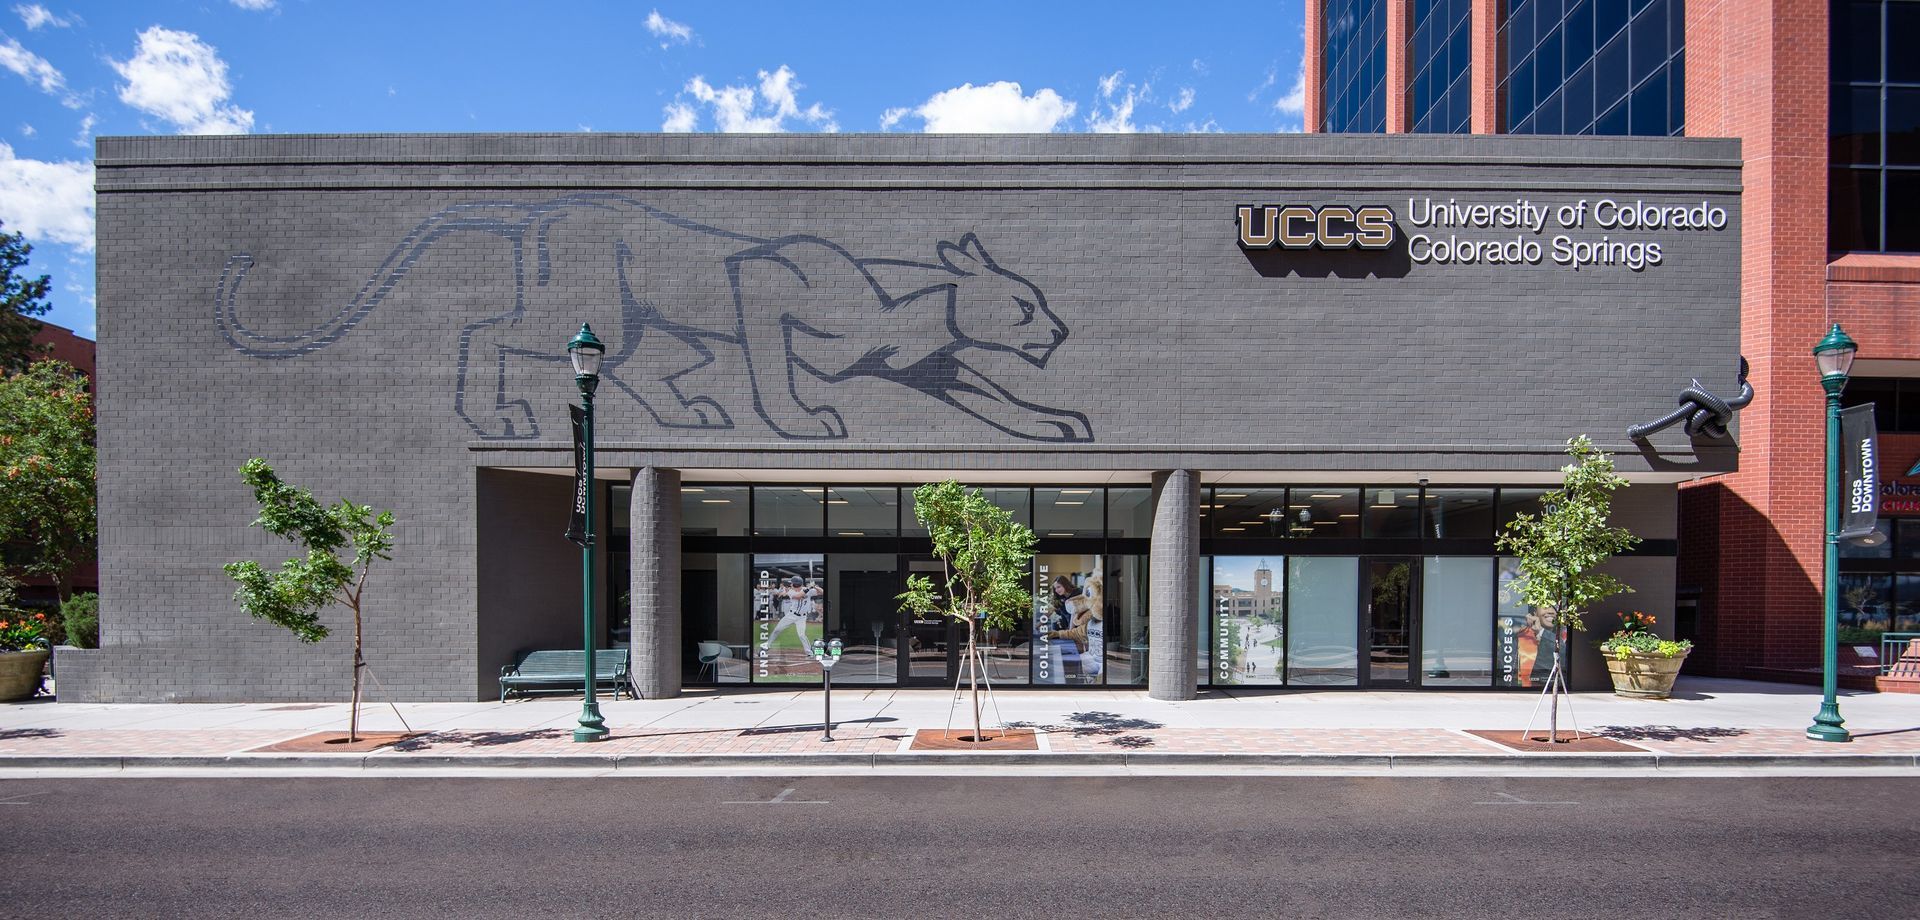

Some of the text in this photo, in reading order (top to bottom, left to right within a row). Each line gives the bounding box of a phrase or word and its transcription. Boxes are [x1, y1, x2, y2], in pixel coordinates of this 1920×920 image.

[1237, 205, 1395, 248] UCCS
[1408, 198, 1726, 231] University of Colorado
[1408, 234, 1662, 269] Colorado Springs
[1851, 479, 1862, 513] UCCS
[1861, 438, 1873, 512] DOWNTOWN
[759, 570, 769, 678] UNPARALLELED
[1039, 565, 1048, 679] COLLABORATIVE
[1219, 596, 1229, 679] COMMUNITY
[1503, 618, 1513, 682] SUCCESS
